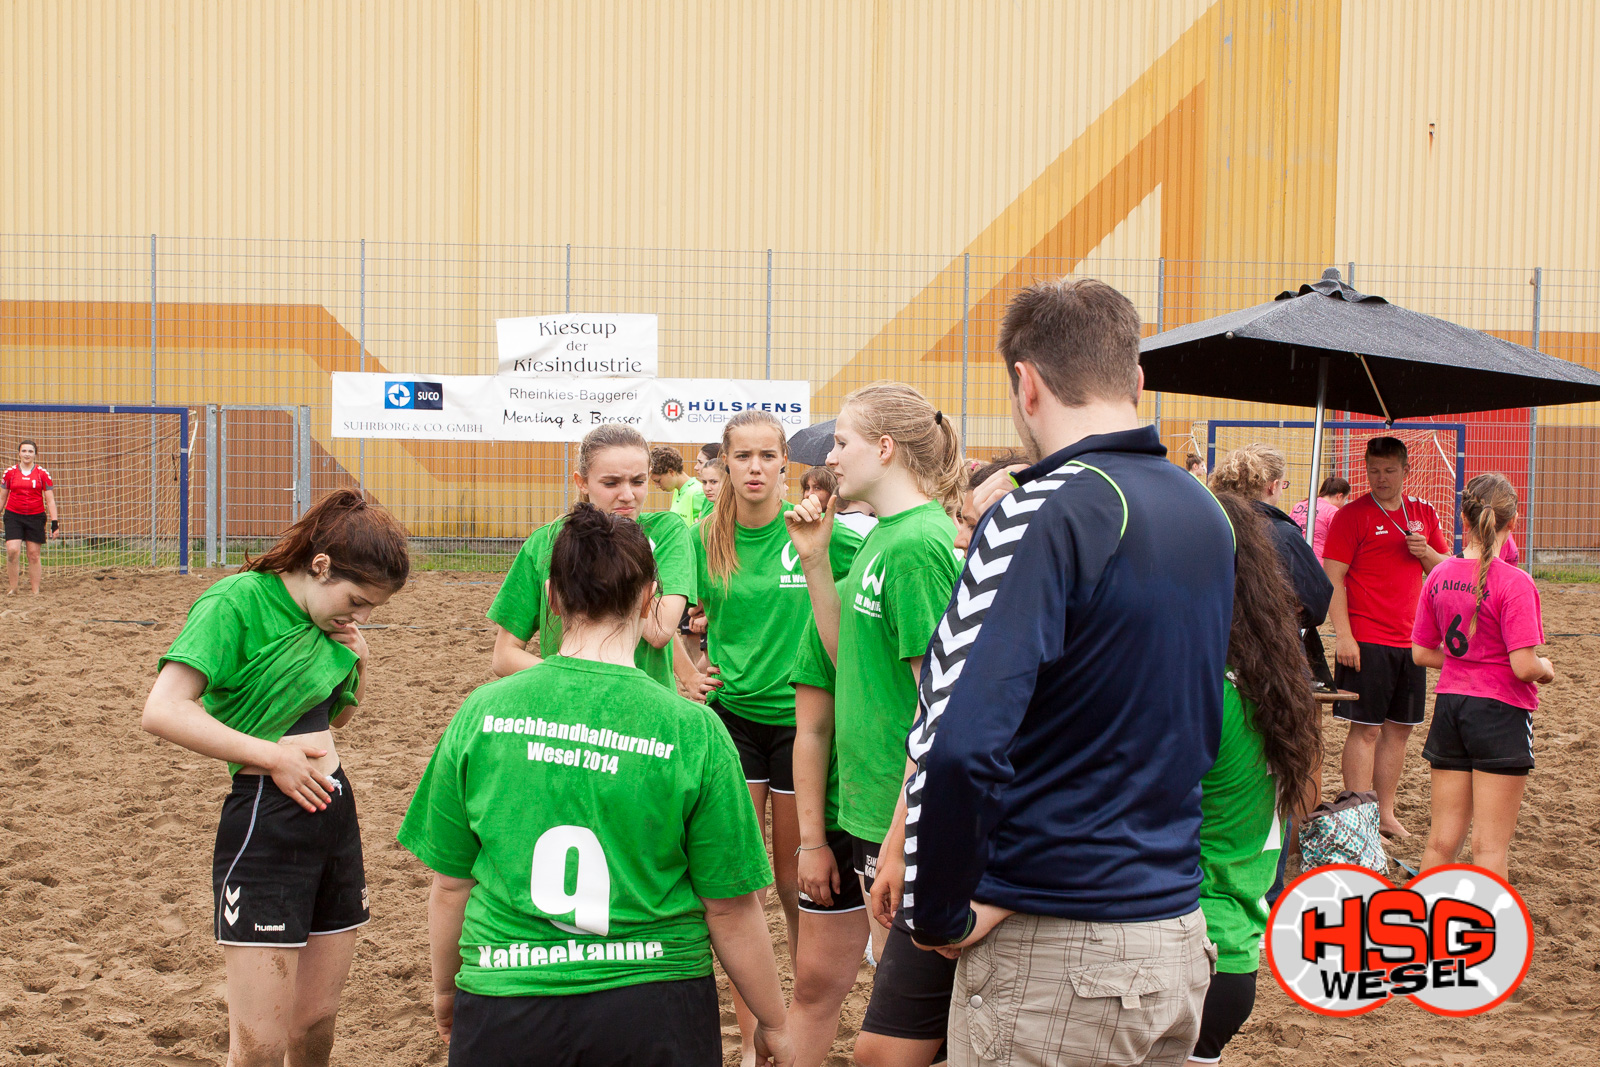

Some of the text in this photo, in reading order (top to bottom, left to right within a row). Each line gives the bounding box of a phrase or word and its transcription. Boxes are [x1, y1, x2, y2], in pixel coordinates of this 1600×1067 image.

[539, 320, 617, 339] Kiescup
[566, 340, 589, 352] der
[513, 356, 642, 373] Kiesindustrie
[417, 390, 440, 402] SUCO
[509, 387, 638, 404] Rheinkies-Baggerei
[688, 398, 802, 413] HÜLSKENS
[343, 420, 484, 434] SUHRBORG & CO. GMBH
[502, 408, 643, 430] Menting & Bresser
[781, 414, 802, 425] KG
[31, 479, 37, 489] 1
[1441, 579, 1491, 602] Aldekek
[1444, 613, 1469, 658] 6
[482, 714, 675, 760] Beachhandballturnier
[527, 741, 620, 775] Wesel 2014
[530, 824, 611, 937] 9
[254, 922, 286, 932] hummel
